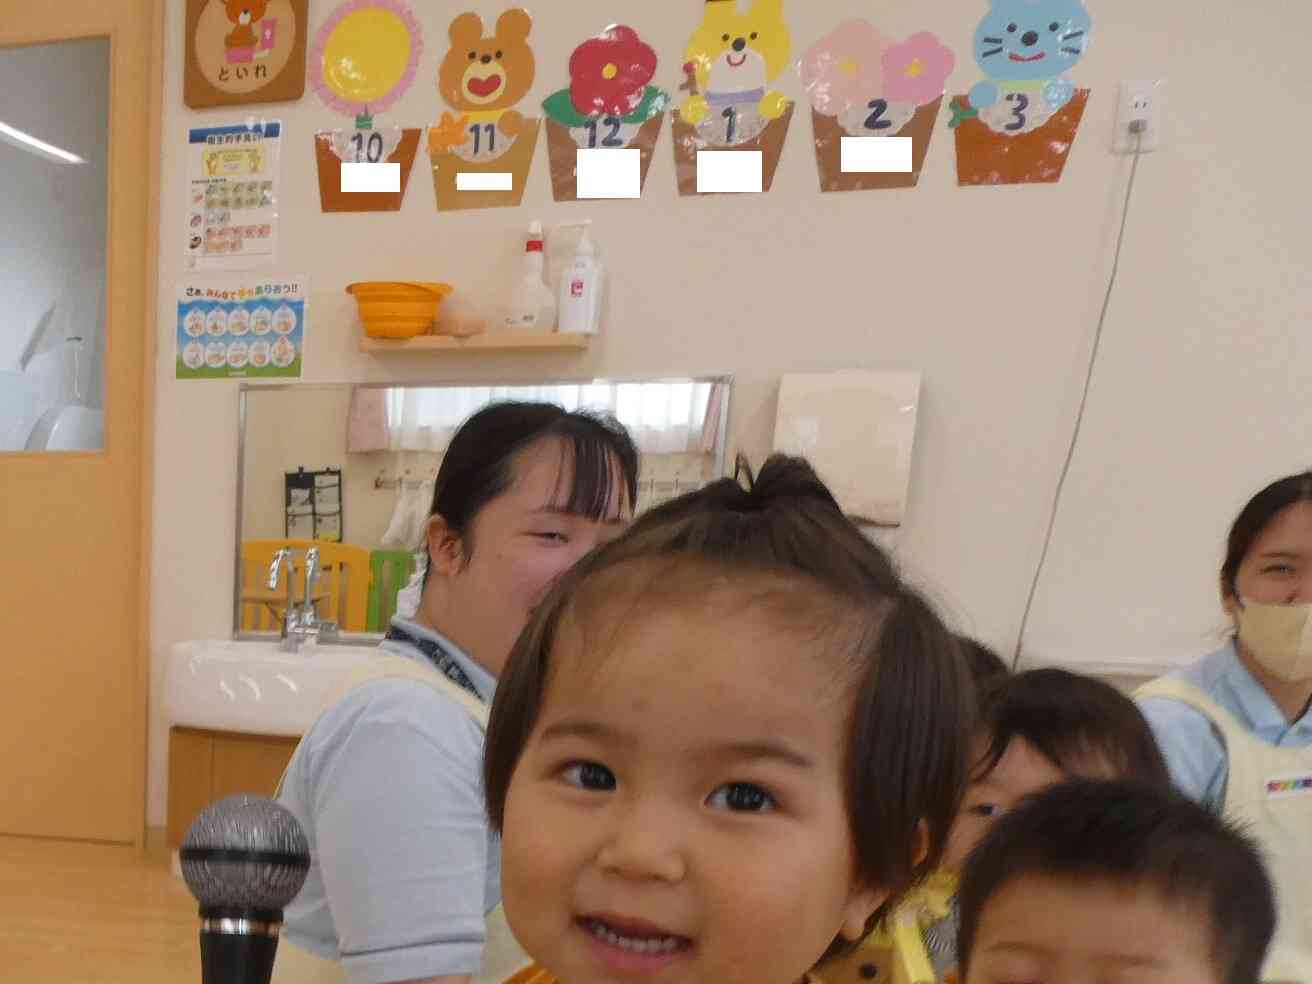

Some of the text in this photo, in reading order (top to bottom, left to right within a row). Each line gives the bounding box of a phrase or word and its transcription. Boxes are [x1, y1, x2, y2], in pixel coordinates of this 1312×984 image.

[218, 63, 268, 81] といれ
[721, 106, 736, 143] 1
[863, 99, 892, 130] 2
[1005, 93, 1029, 131] 3
[351, 131, 384, 163] 10
[469, 123, 496, 155] 11
[584, 116, 623, 148] 12
